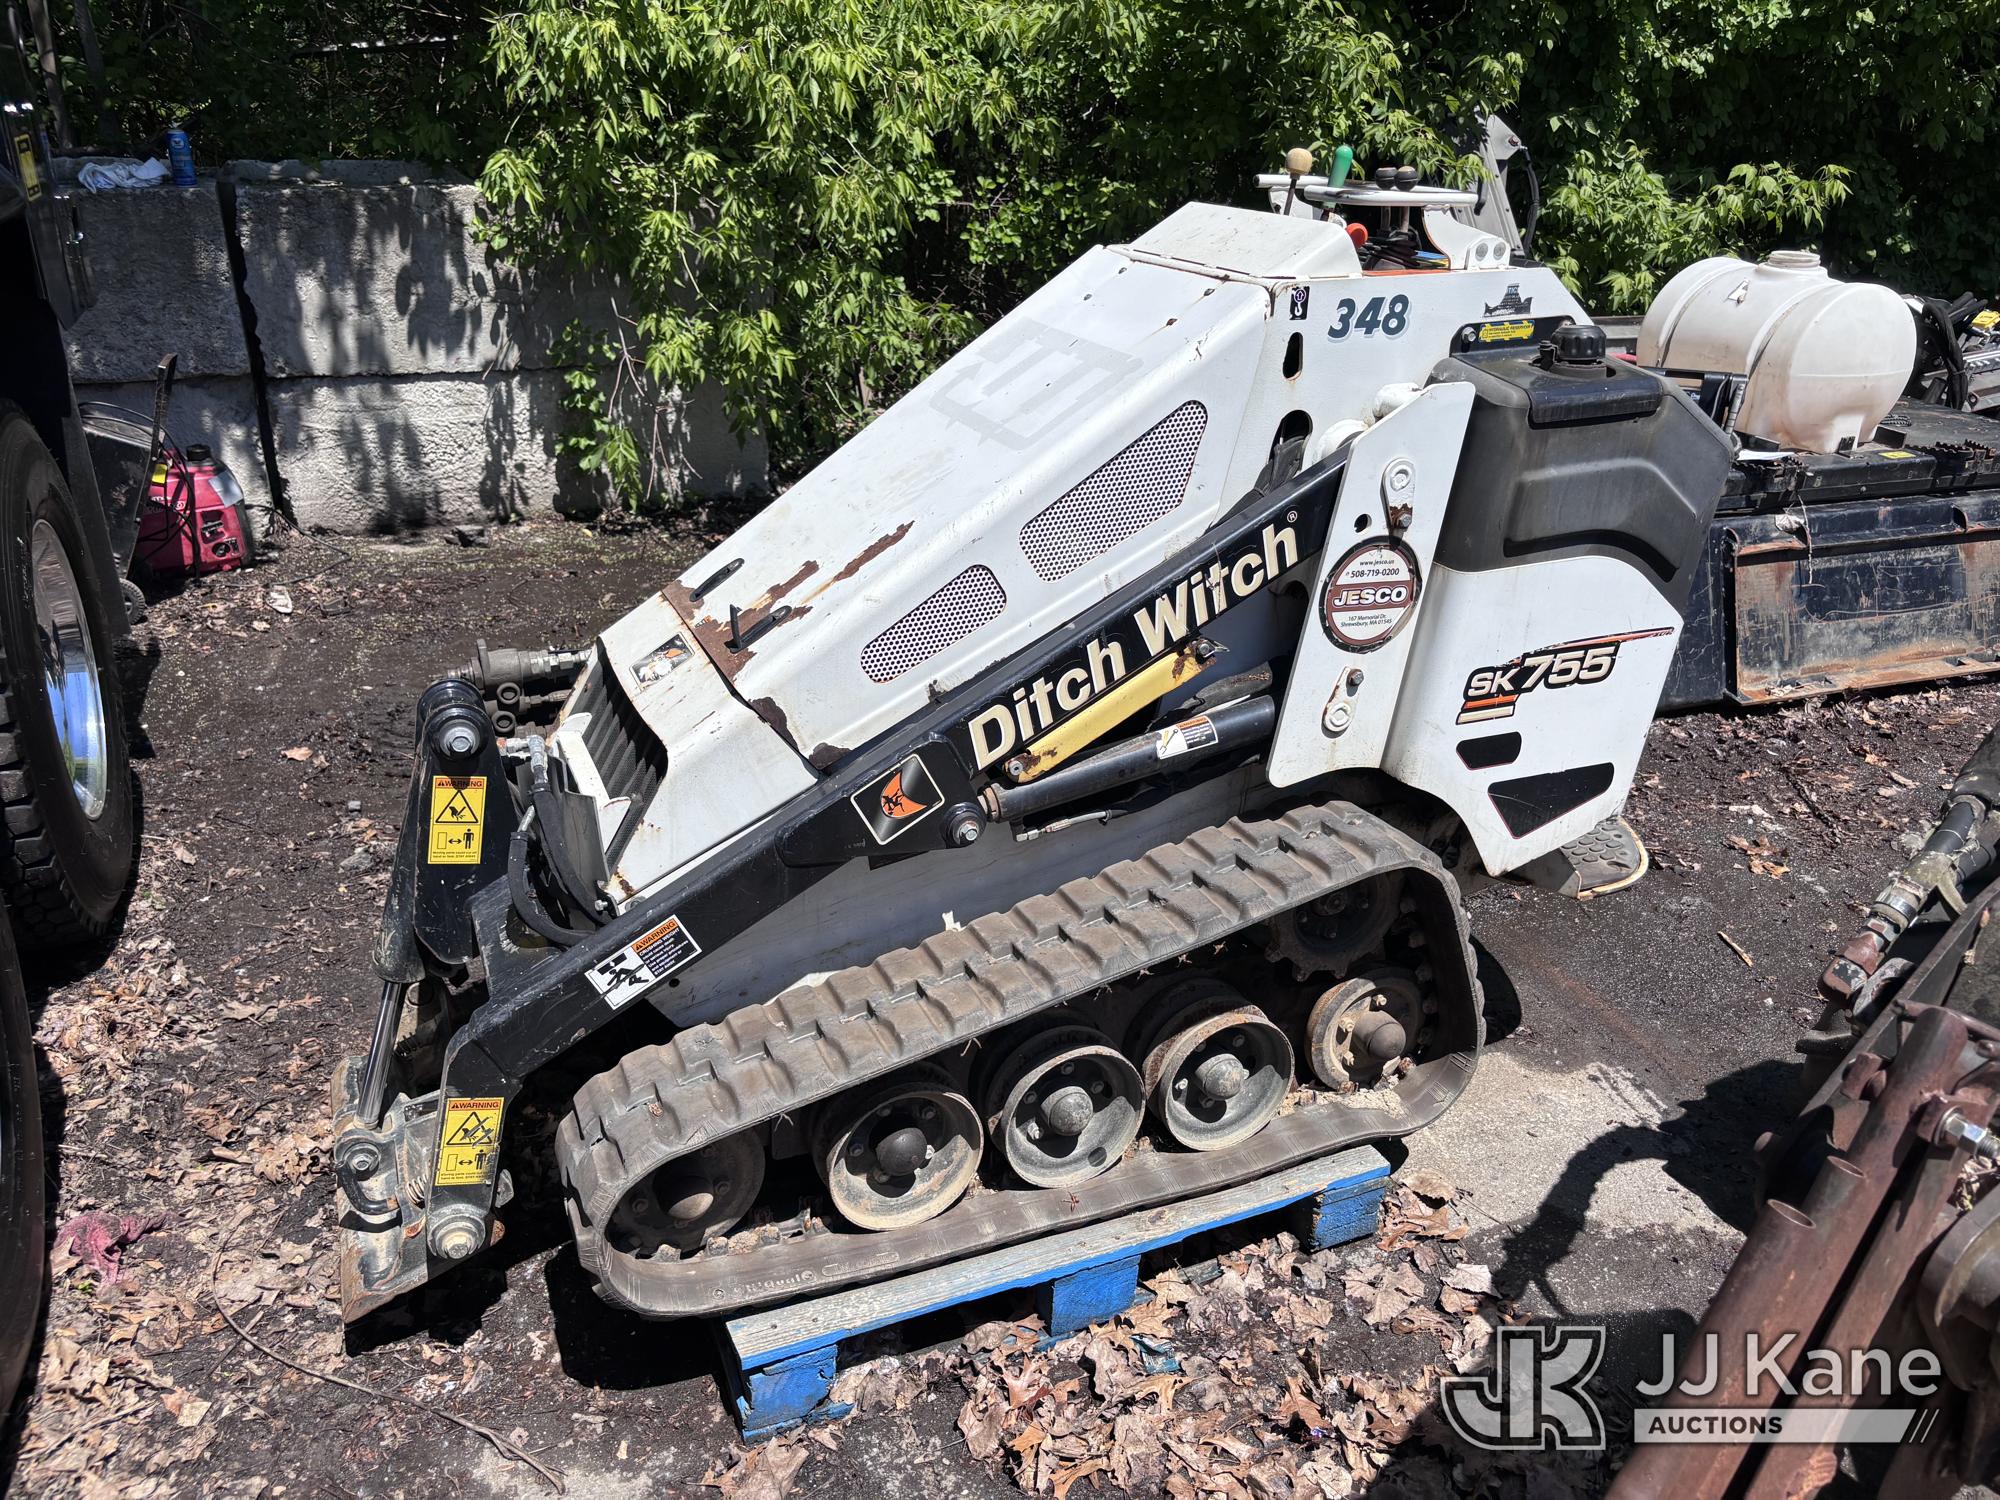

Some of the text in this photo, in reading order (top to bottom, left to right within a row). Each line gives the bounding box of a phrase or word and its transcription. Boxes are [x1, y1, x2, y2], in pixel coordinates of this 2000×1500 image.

[1327, 293, 1411, 342] 348
[1350, 568, 1399, 578] 508-719-0200
[1333, 586, 1408, 607] JESCO
[968, 524, 1299, 771] Ditch Witch
[640, 921, 676, 946] WARNING
[458, 1101, 499, 1109] WARNING
